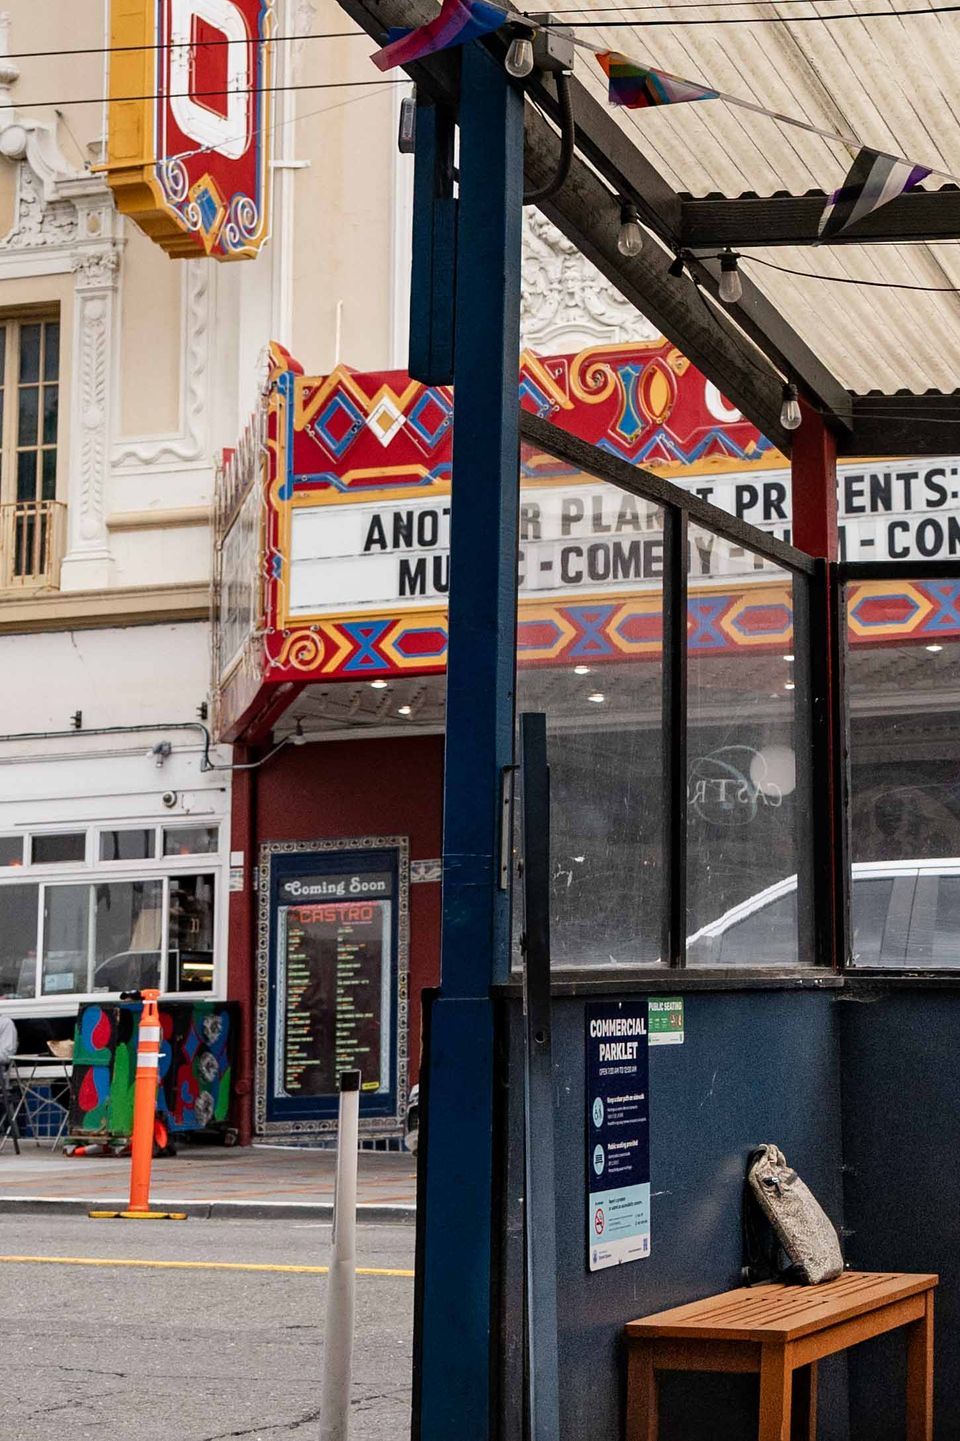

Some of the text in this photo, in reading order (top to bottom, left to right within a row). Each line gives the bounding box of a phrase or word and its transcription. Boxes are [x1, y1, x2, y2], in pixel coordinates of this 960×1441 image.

[363, 503, 541, 552] ANOR
[561, 486, 714, 536] PLAT
[735, 466, 959, 521] PRENTS:
[560, 534, 715, 584] COMEY
[284, 876, 386, 896] Coming Soon
[299, 906, 373, 924] CASTRO
[648, 1001, 682, 1011] PUBLIC SEATING
[590, 1018, 647, 1038] COMMERCIAL
[599, 1042, 638, 1062] PARKLET
